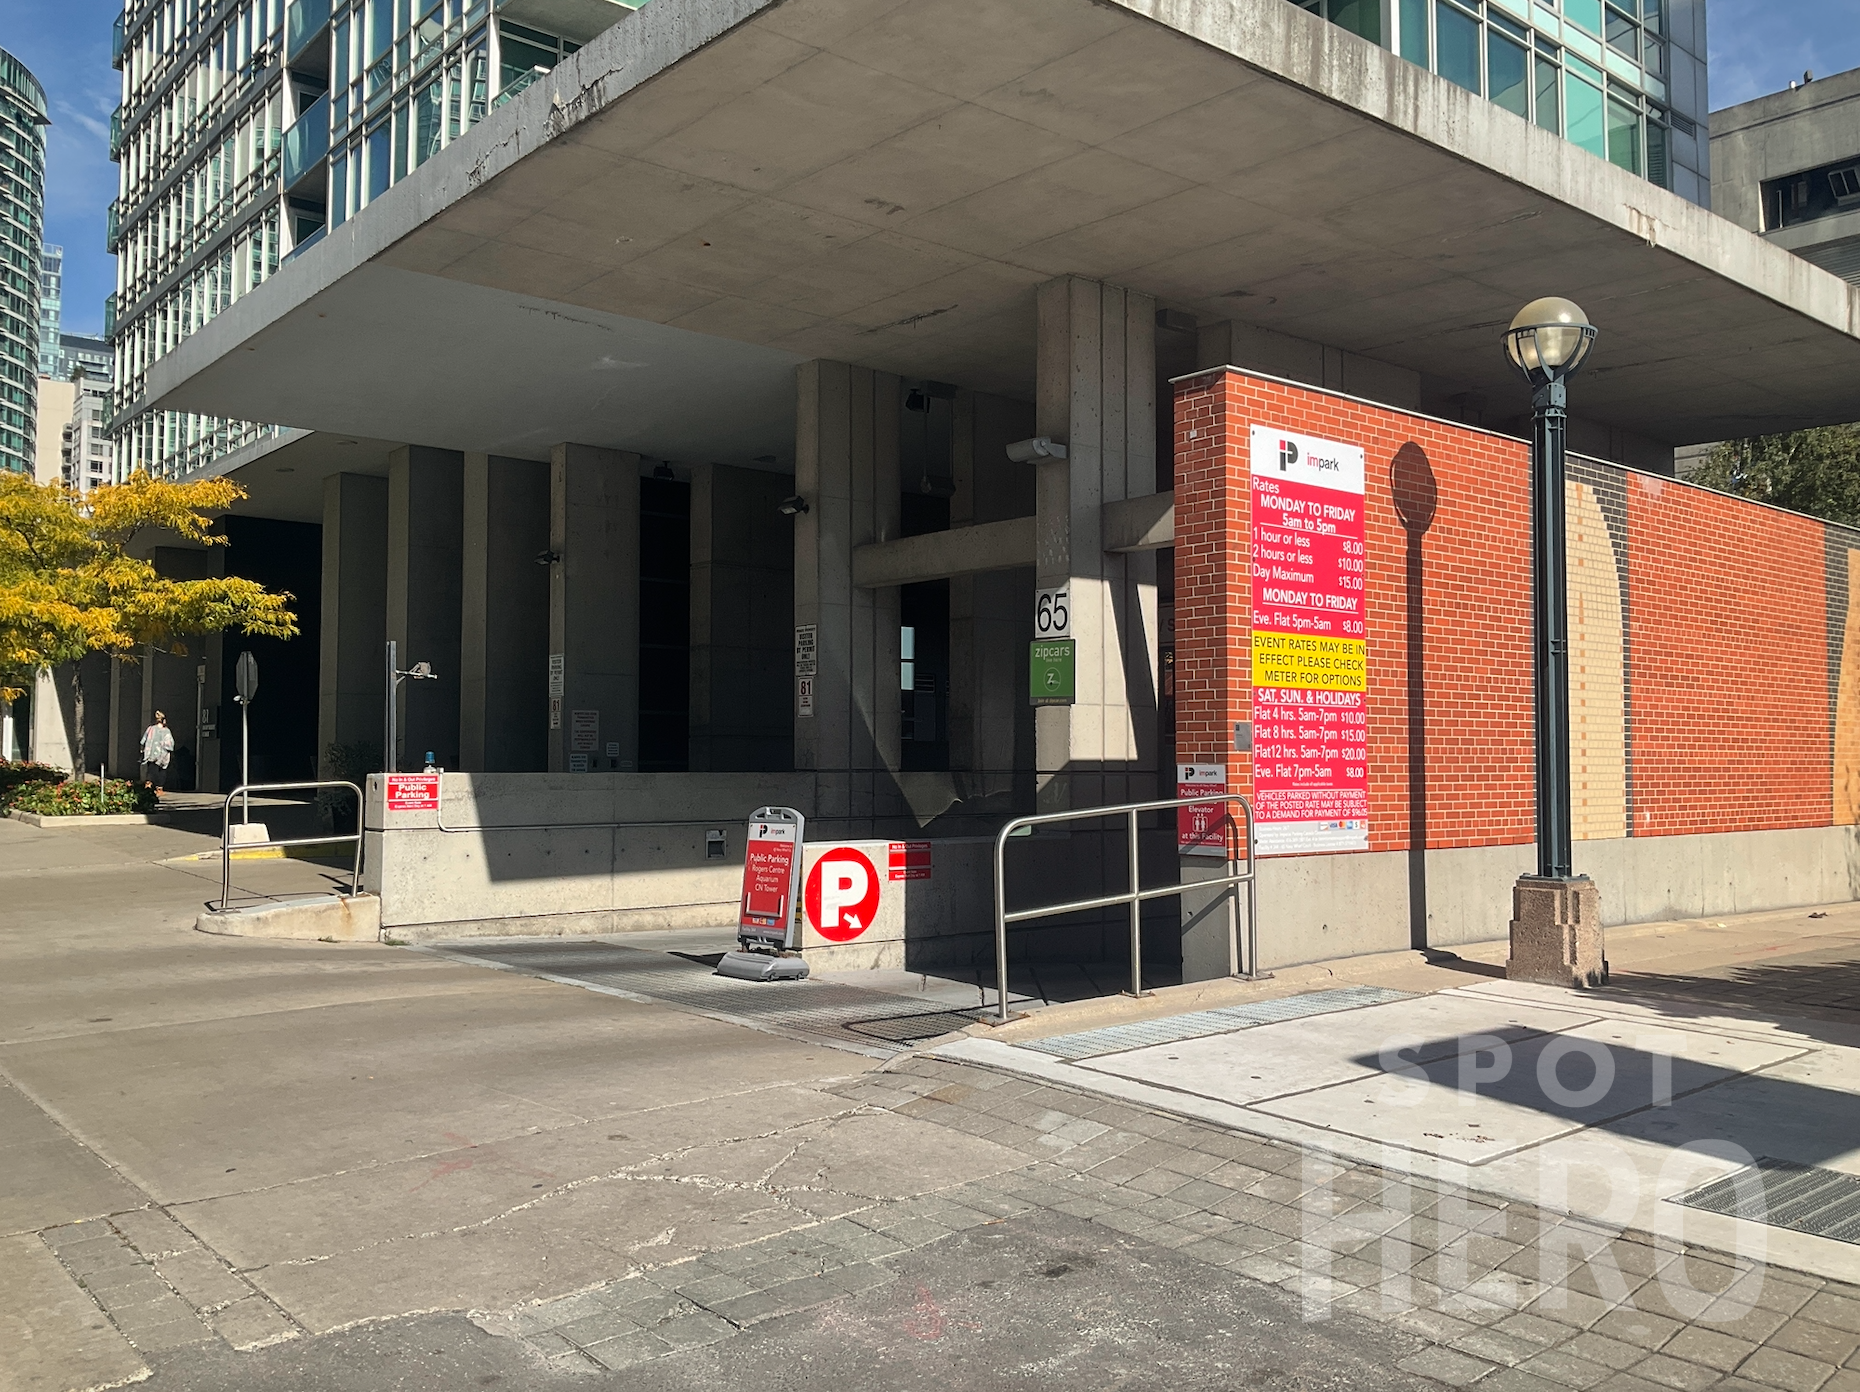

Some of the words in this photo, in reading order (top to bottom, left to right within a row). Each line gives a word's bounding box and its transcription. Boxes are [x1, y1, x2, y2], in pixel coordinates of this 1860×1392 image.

[1307, 452, 1340, 472] impark
[1253, 477, 1280, 493] Rates
[1261, 494, 1305, 513] MONDAY
[1308, 502, 1321, 516] TO
[1324, 505, 1356, 522] FRIDAY
[1282, 513, 1302, 528] 5am
[1304, 518, 1314, 530] to
[1316, 519, 1336, 535] 5pm
[1253, 527, 1258, 540] 1
[1261, 527, 1281, 543] hour
[1283, 535, 1293, 544] or
[1295, 532, 1310, 547] less
[1343, 541, 1363, 555] $8.00
[1253, 544, 1259, 557] 2
[1261, 544, 1285, 561] hours
[1286, 552, 1296, 562] or
[1298, 549, 1313, 565] less
[1338, 558, 1363, 572] $10.00
[1253, 563, 1270, 582] Day
[1272, 566, 1314, 583] Maximum
[1338, 576, 1363, 590] $15.00
[1263, 587, 1308, 604] MONDAY
[1310, 593, 1323, 607] TO
[1326, 595, 1358, 610] FRIDAY
[1038, 593, 1067, 632] 65
[1253, 610, 1272, 625] Eve.
[1274, 612, 1290, 627] Flat
[1292, 614, 1331, 631] 5pm-5am
[1343, 620, 1363, 634] $8.00
[1035, 645, 1070, 660] zipcars
[1254, 636, 1286, 649] EVENT
[1289, 639, 1317, 652] RATES
[1320, 642, 1340, 653] MAY
[1343, 644, 1353, 654] BE
[1356, 645, 1365, 655] IN
[1260, 653, 1294, 666] EFFECT
[1298, 656, 1331, 668] PLEASE
[1334, 659, 1364, 671] CHECK
[1265, 670, 1297, 682] METER
[1300, 673, 1319, 684] FOR
[1322, 674, 1362, 686] OPTIONS
[801, 681, 811, 695] 81
[553, 700, 560, 712] 81
[1281, 690, 1303, 703] SUN.
[1306, 691, 1313, 704] &
[1316, 692, 1361, 706] HOLIDAYS
[1254, 706, 1271, 720] Flat
[1272, 708, 1278, 719] 4
[1281, 707, 1296, 721] hrs.
[1298, 708, 1337, 725] 5am-7pm
[1341, 712, 1365, 724] $10.00
[1254, 725, 1271, 738] Flat
[1273, 725, 1279, 738] 8
[1281, 725, 1296, 739] hrs.
[1299, 726, 1338, 743] 5am-7pm
[1341, 730, 1365, 742] $15.00
[1283, 745, 1298, 758] hrs.
[1301, 745, 1338, 762] 5am-7pm
[1342, 748, 1365, 760] $20.00
[1255, 764, 1273, 778] Eve.
[1276, 764, 1291, 778] Flat
[1294, 764, 1332, 781] 7pm-5am
[1346, 767, 1364, 778] $8.00
[395, 791, 430, 800] Parking
[1256, 793, 1286, 801] VEHICLES
[1287, 792, 1310, 800] PARKED
[1340, 791, 1366, 799] PAYMENT
[1256, 802, 1265, 810] OF
[1280, 801, 1304, 809] POSTED
[1305, 800, 1320, 808] RATE
[1321, 800, 1333, 808] MAY
[1335, 800, 1342, 808] BE
[1343, 800, 1367, 808] SUBJECT
[1255, 811, 1265, 819] TO
[1266, 811, 1271, 819] A
[1272, 810, 1300, 819] DEMAND
[1301, 810, 1313, 818] FOR
[1314, 809, 1342, 817] PAYMENT
[771, 828, 785, 836] impark
[1202, 833, 1223, 842] Facility
[750, 853, 767, 862] Public
[768, 854, 789, 866] Parking
[752, 864, 768, 874] Rogers
[769, 866, 785, 874] Centre
[756, 875, 778, 883] Aquarium
[764, 884, 778, 892] Tower
[820, 861, 868, 928] P
